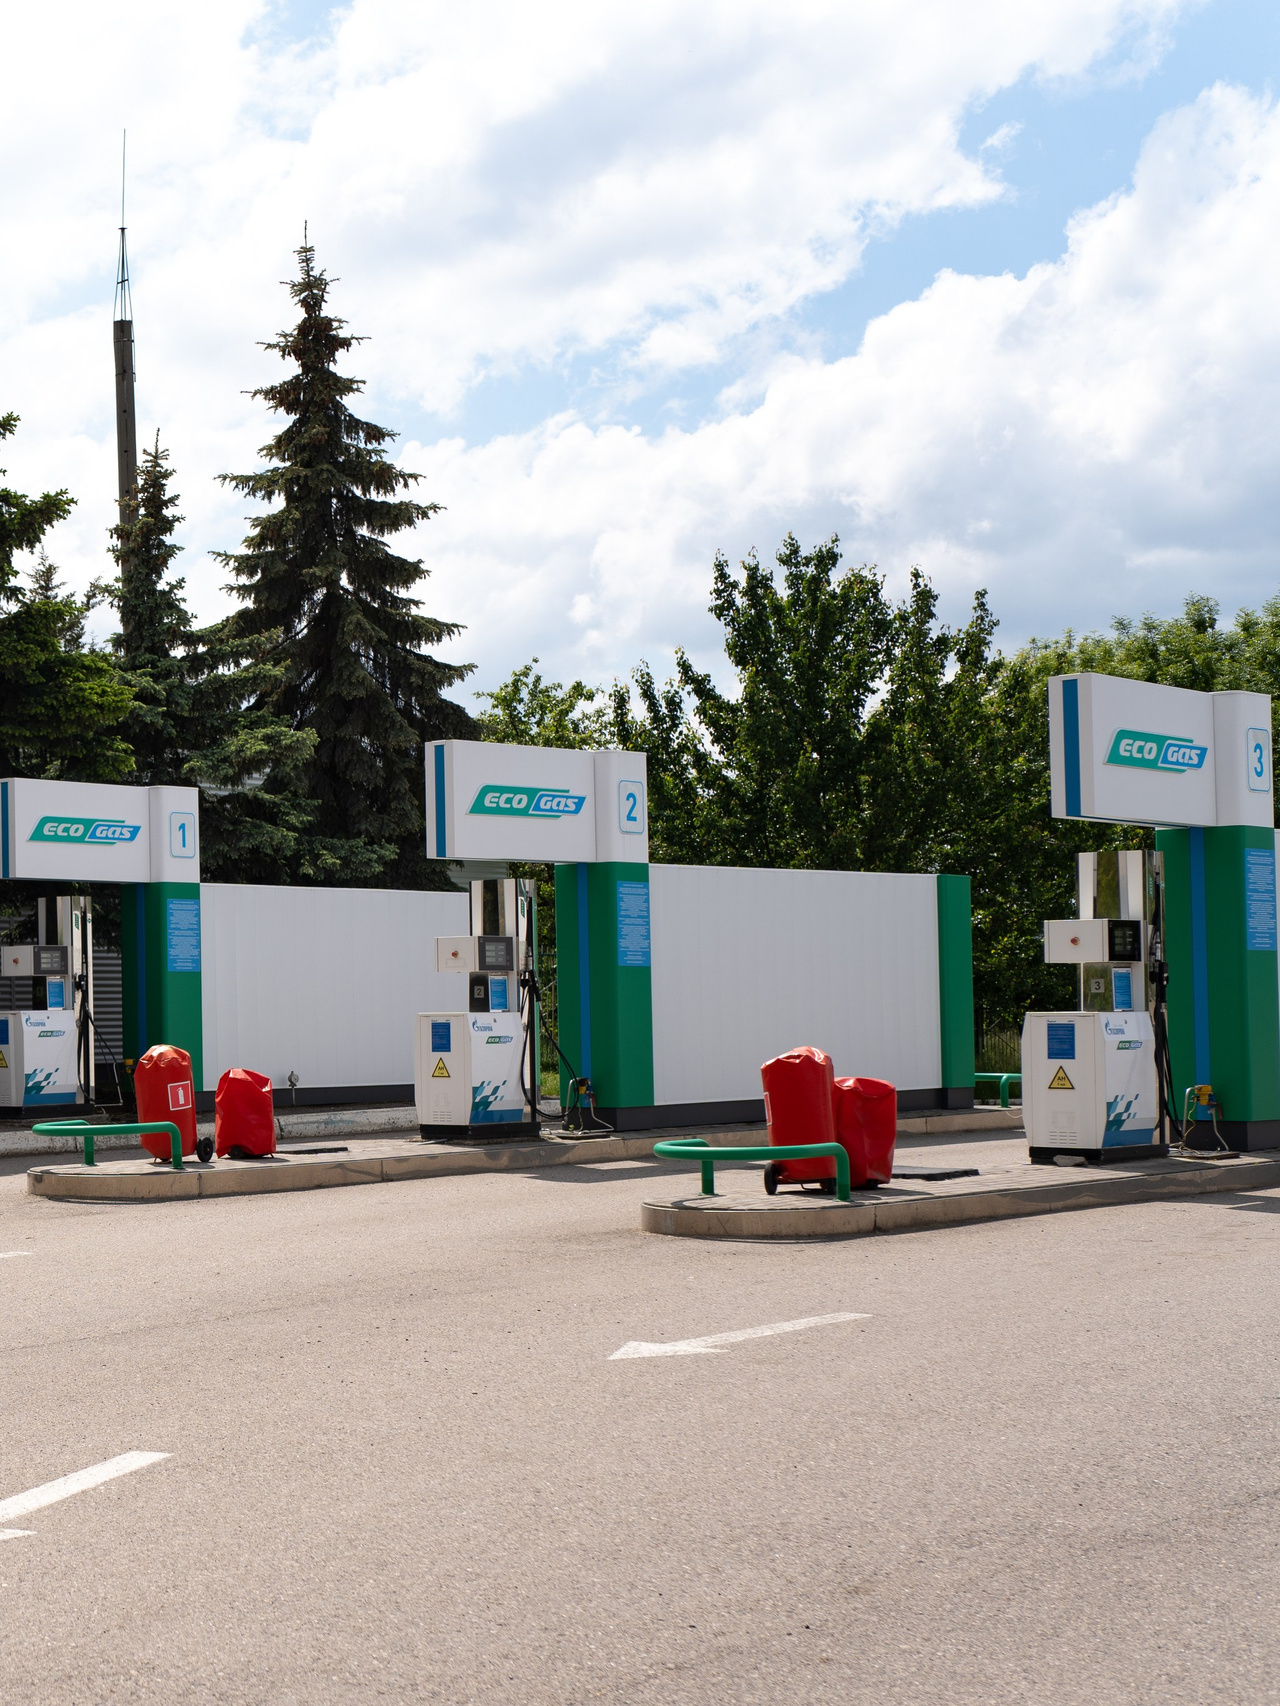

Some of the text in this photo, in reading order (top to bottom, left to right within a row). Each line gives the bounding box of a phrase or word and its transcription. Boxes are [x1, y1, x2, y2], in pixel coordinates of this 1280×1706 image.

[1118, 738, 1158, 760] ECO
[1253, 742, 1264, 778] 3
[483, 792, 528, 809] ECO
[625, 792, 638, 822] 2
[42, 822, 85, 837] ECO
[177, 822, 187, 849] 1
[476, 988, 482, 996] 2
[1094, 981, 1101, 991] 3
